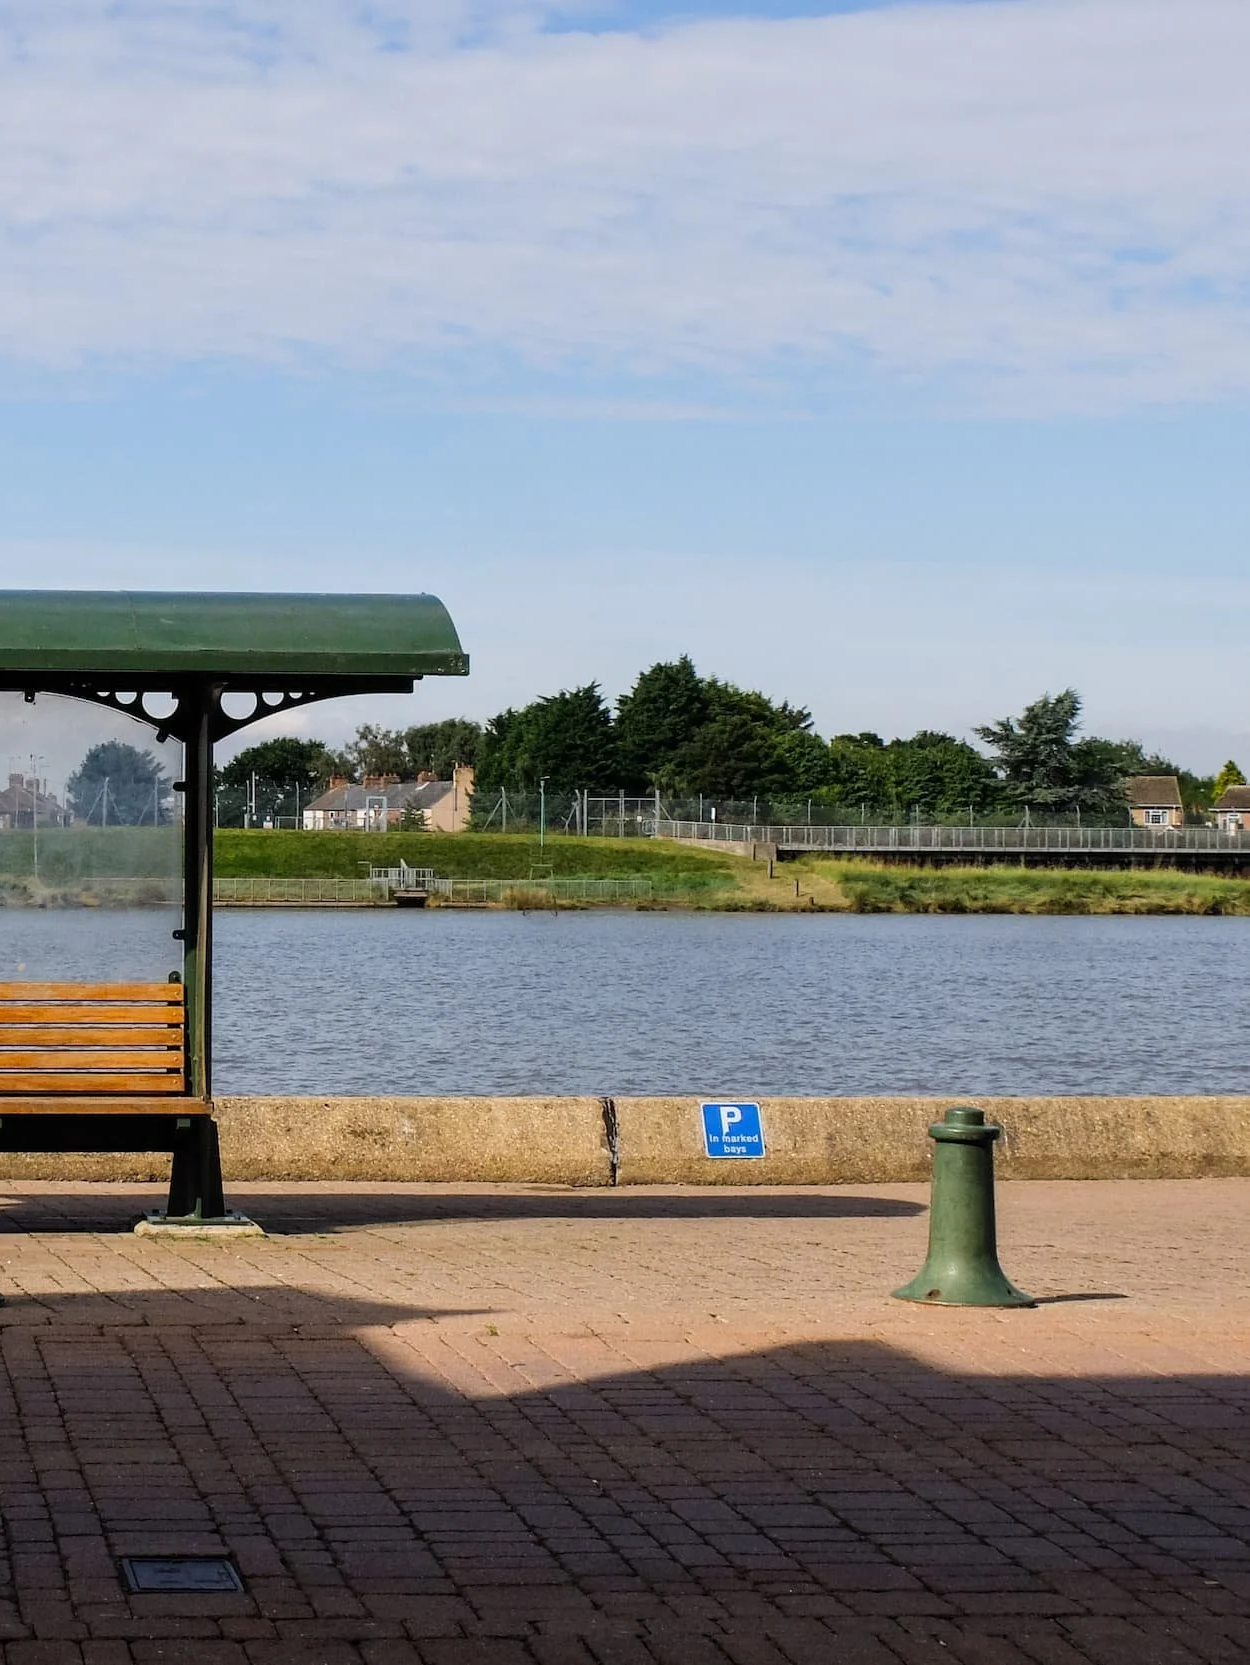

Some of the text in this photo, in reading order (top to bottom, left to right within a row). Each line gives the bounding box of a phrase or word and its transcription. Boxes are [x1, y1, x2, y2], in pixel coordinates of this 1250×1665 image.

[720, 1106, 741, 1134] P
[723, 1133, 759, 1143] marked
[724, 1144, 747, 1155] bays
